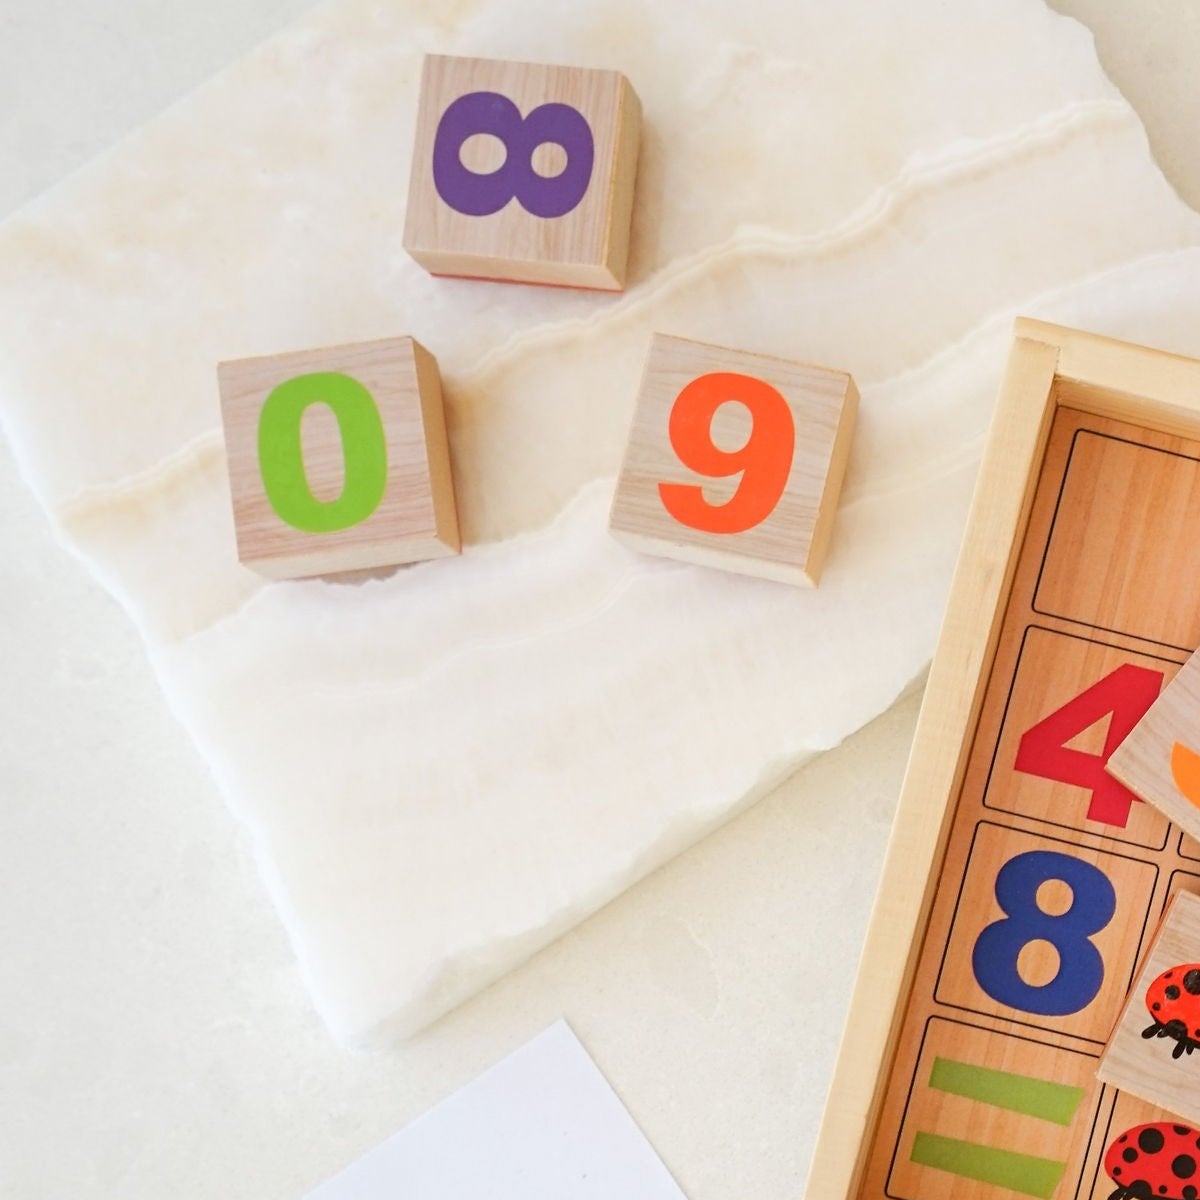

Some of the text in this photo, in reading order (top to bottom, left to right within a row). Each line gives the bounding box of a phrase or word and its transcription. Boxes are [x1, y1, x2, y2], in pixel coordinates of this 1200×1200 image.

[433, 91, 595, 219] 8
[258, 371, 388, 534] 0
[658, 371, 795, 534] 9
[1014, 663, 1165, 829] 4
[971, 850, 1117, 1016] 8
